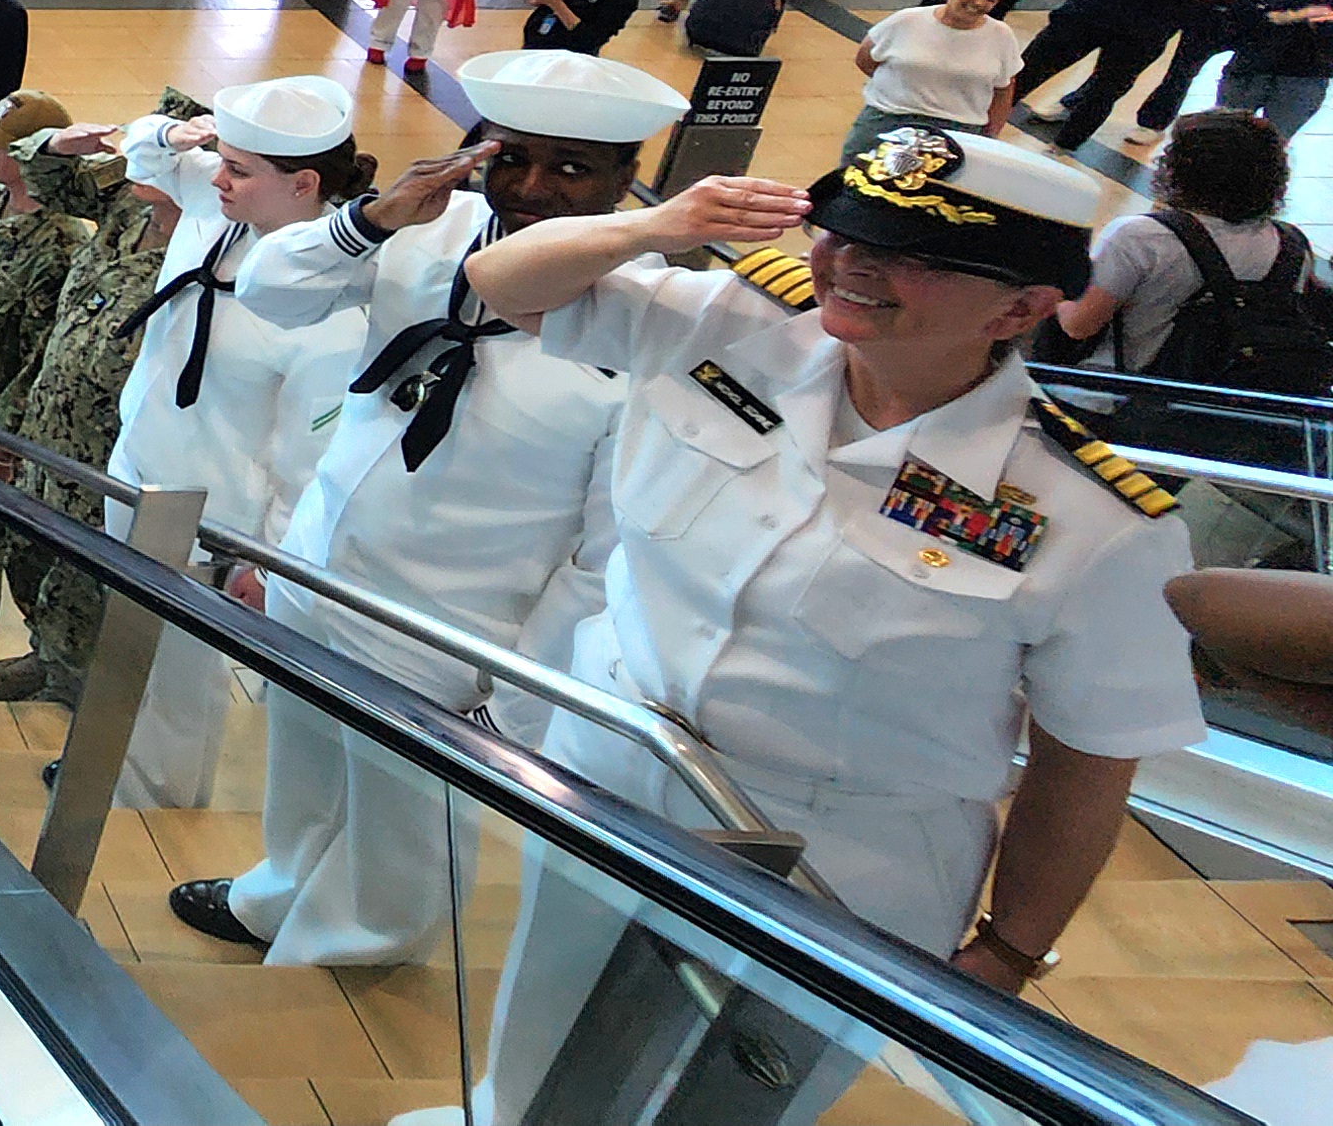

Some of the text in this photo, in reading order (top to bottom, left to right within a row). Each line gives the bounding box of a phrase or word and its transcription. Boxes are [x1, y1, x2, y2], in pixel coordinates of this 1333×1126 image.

[730, 72, 751, 83] NO
[707, 86, 764, 96] RE-ENTRY
[706, 99, 754, 110] BEYOND
[694, 113, 759, 124] THIS POINT
